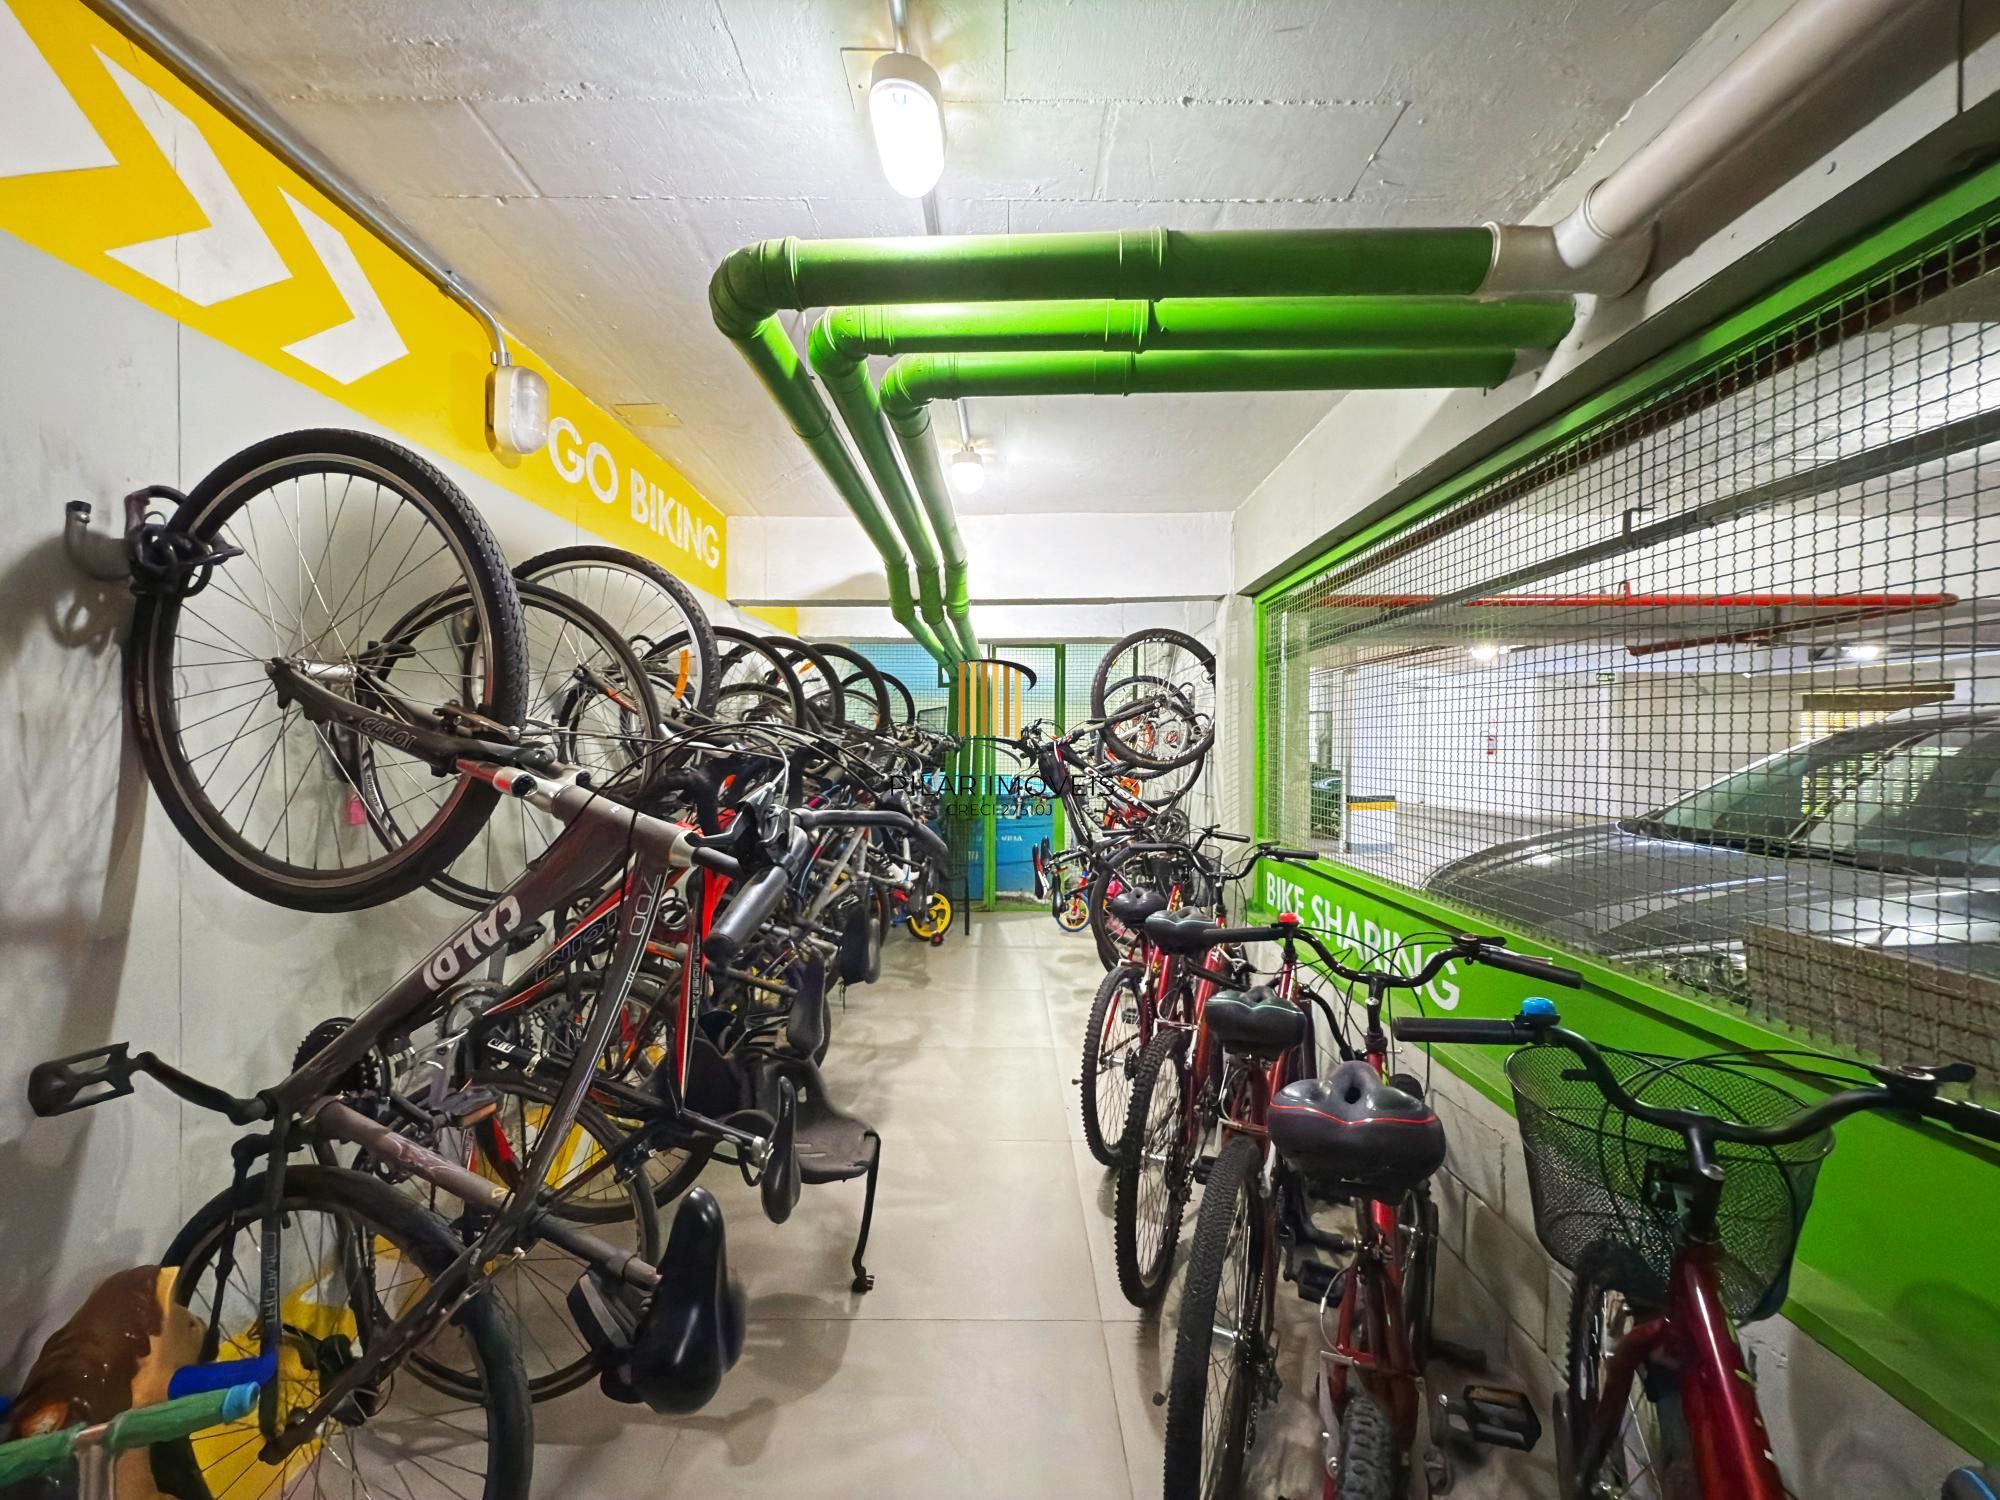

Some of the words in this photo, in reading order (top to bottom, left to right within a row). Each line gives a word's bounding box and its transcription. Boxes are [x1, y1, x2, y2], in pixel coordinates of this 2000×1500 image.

[548, 416, 618, 504] GO
[630, 468, 720, 569] BIKING
[359, 717, 417, 750] CALOI
[423, 895, 522, 991] CALOI
[1266, 871, 1305, 927] BIKE
[1311, 895, 1461, 1011] SHARING
